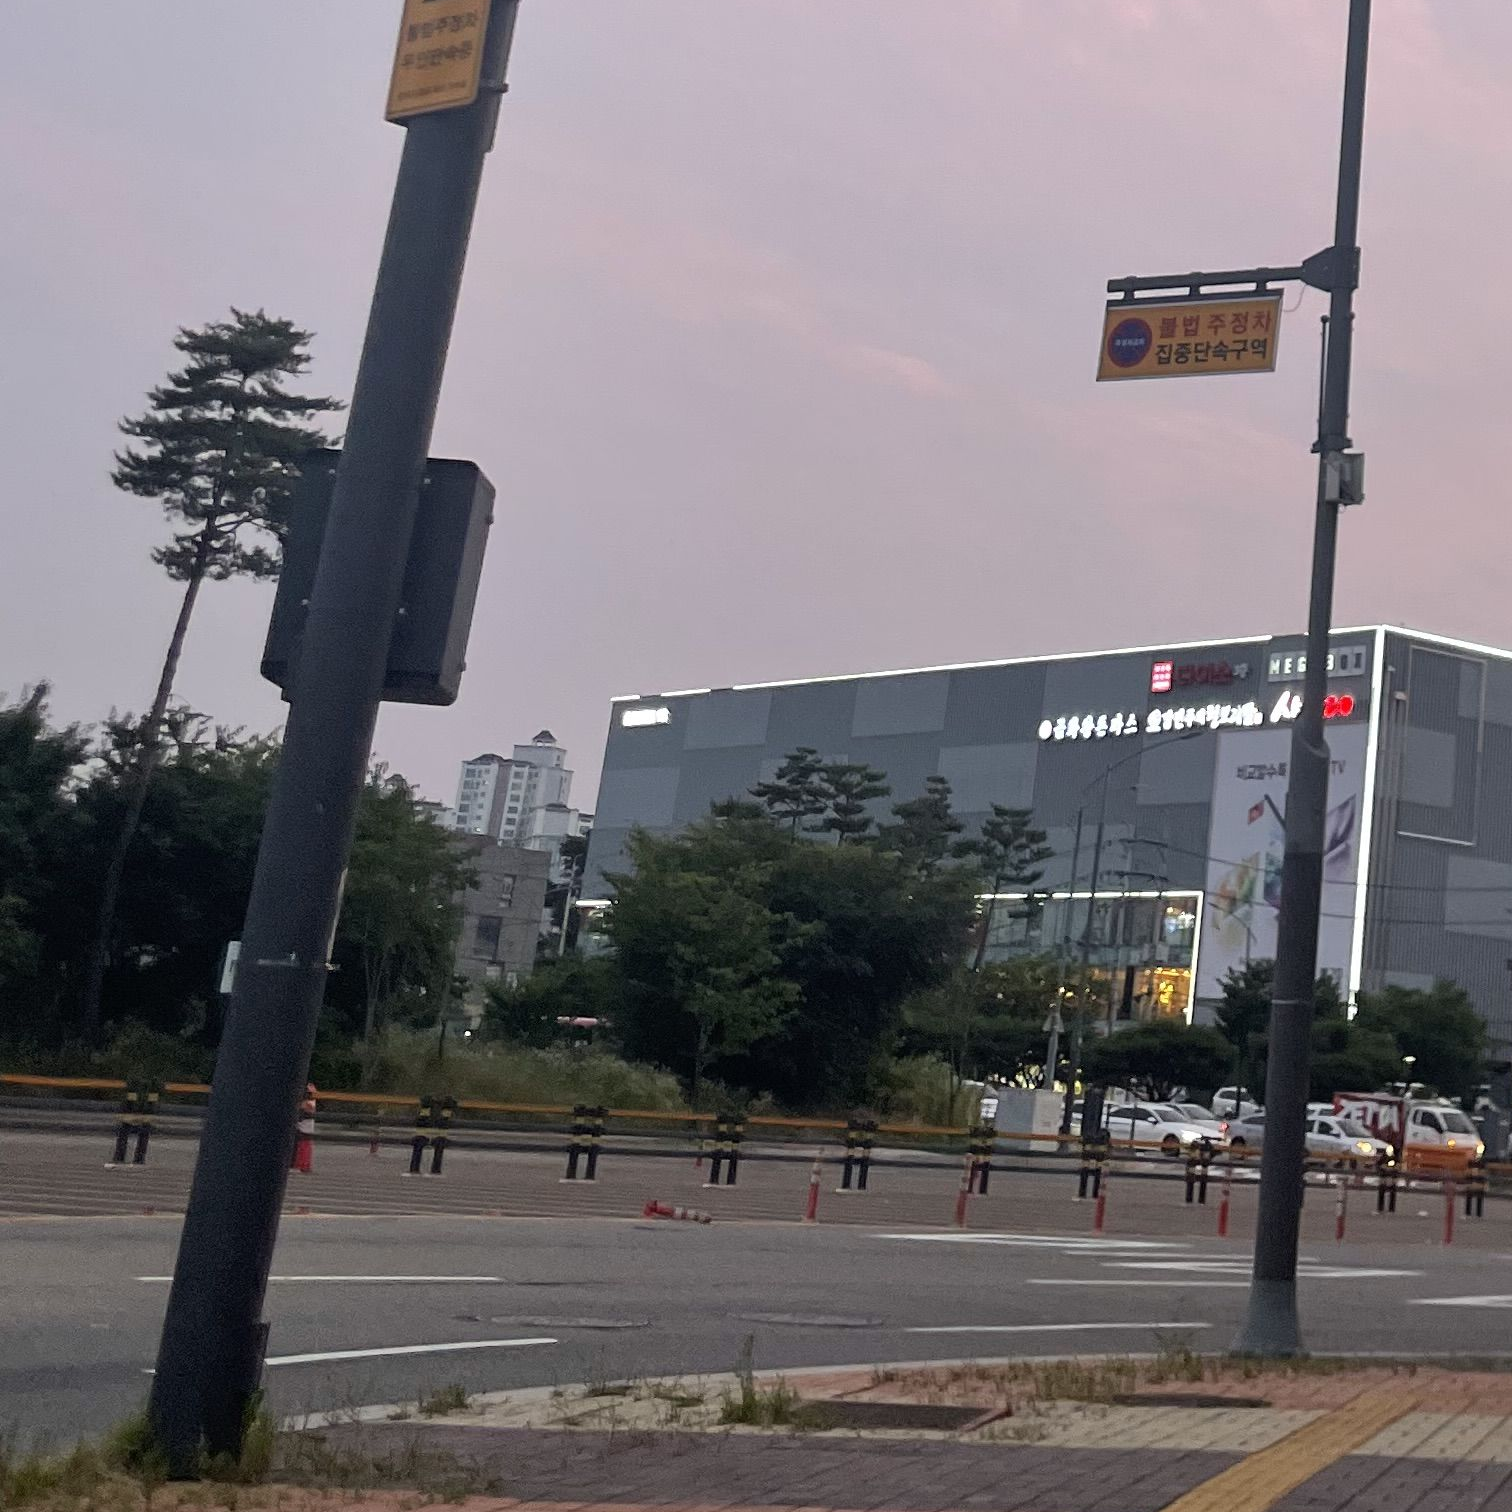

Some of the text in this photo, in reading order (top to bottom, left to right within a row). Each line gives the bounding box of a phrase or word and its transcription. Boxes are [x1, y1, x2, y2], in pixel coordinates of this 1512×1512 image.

[1159, 310, 1272, 338] 불법 주정차
[1155, 338, 1268, 365] 집중단속구역
[1269, 652, 1363, 675] MEGBOX
[1331, 760, 1346, 776] TV
